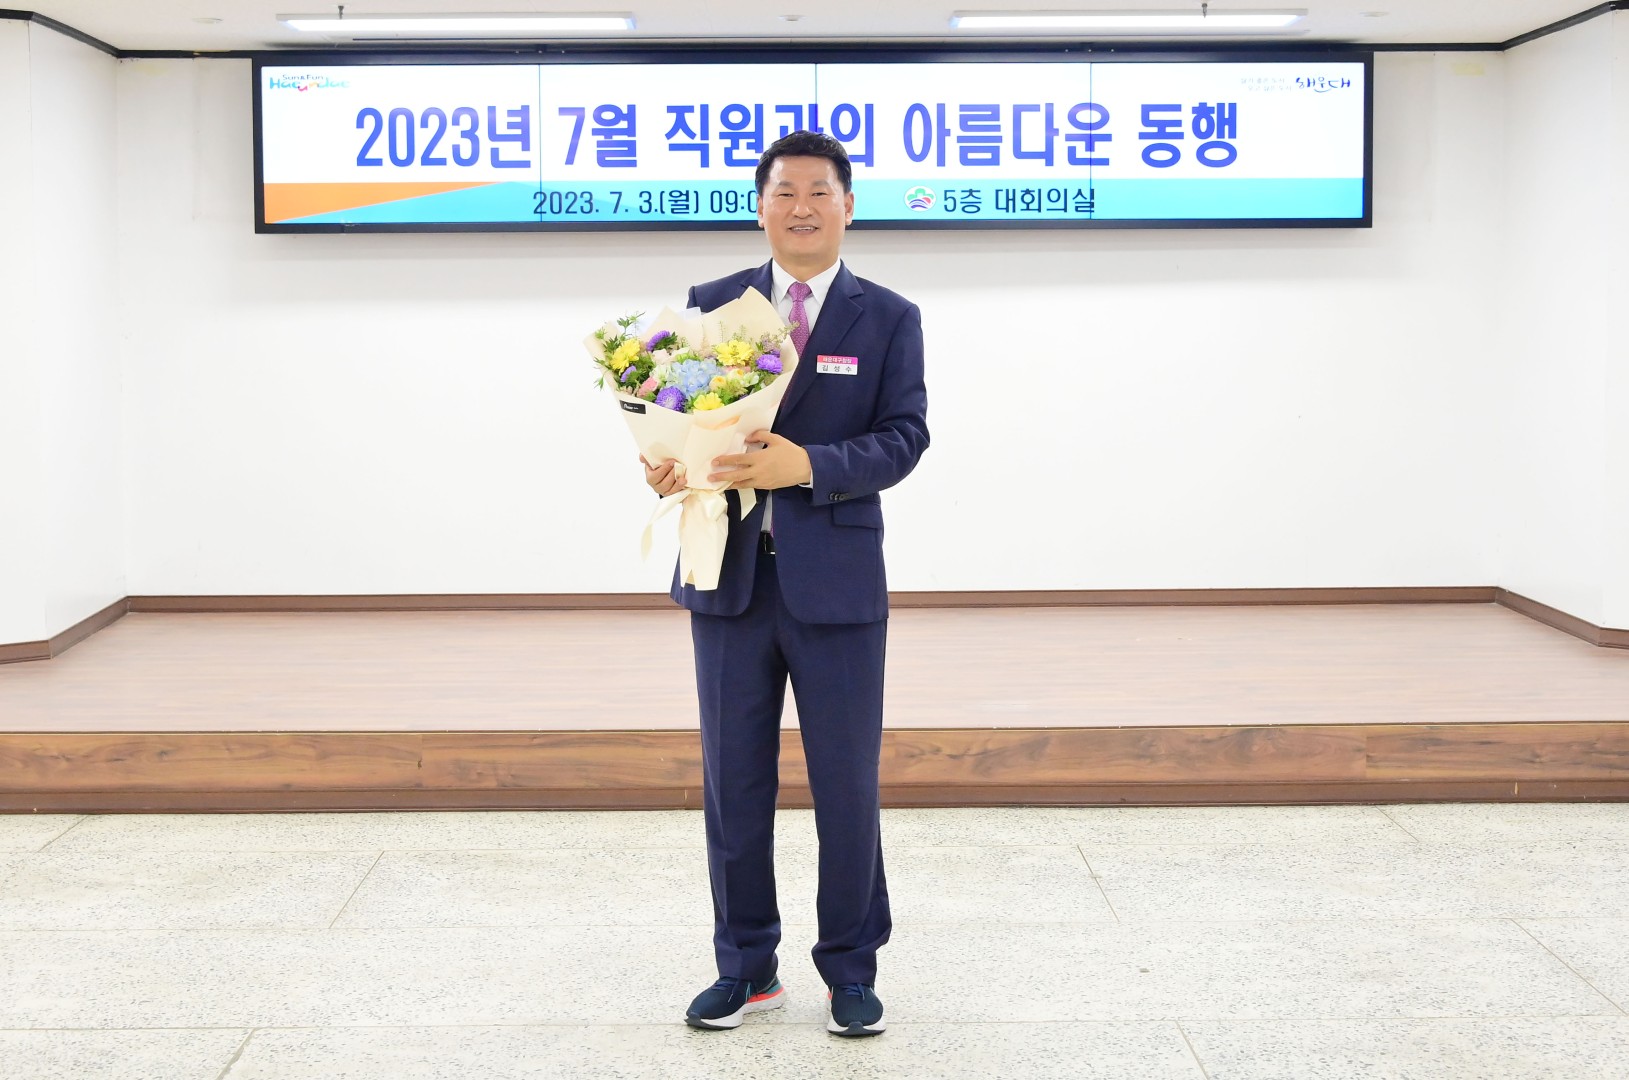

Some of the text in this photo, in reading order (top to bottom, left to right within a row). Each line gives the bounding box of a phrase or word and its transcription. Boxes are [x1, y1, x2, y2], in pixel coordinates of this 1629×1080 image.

[1295, 76, 1351, 93] 해운대
[355, 104, 532, 168] 2023년
[558, 104, 638, 168] 7월
[903, 102, 1113, 167] 아름다운
[1138, 102, 1238, 169] 동행
[533, 191, 600, 215] 2023.
[609, 191, 629, 213] 7.
[710, 190, 757, 214] 09:0
[943, 188, 1095, 214] 5층 대회의실
